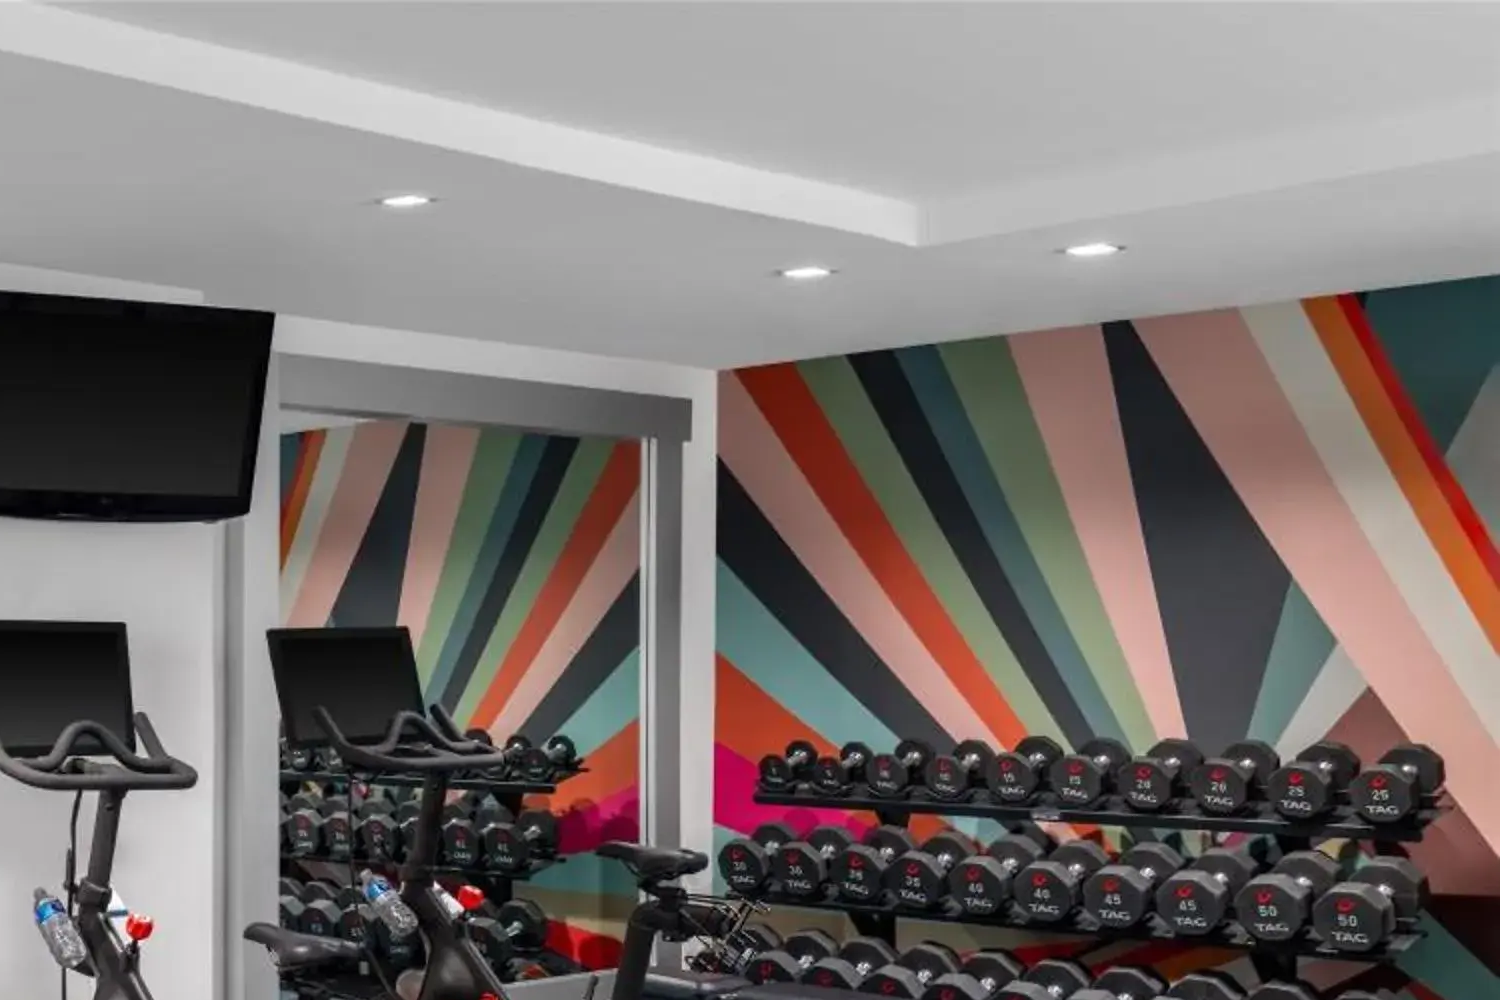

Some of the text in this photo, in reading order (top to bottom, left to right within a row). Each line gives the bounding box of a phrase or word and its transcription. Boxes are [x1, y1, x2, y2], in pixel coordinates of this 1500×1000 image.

[1211, 781, 1226, 793] 20
[1287, 785, 1304, 797] 25
[1371, 789, 1389, 800] 25
[1204, 795, 1234, 807] TAG
[1280, 799, 1312, 811] TAG
[1364, 804, 1399, 816] TAG
[968, 882, 984, 893] 40
[1033, 888, 1050, 899] 40
[963, 897, 993, 907] TAG
[1104, 894, 1121, 905] 45
[1179, 900, 1197, 911] 45
[1028, 902, 1060, 915] TAG
[1258, 905, 1278, 917] 50
[1098, 909, 1131, 921] TAG
[1337, 914, 1358, 928] 50
[1172, 916, 1207, 928] TAG
[1253, 922, 1290, 933] TAG
[1331, 931, 1370, 944] TAG
